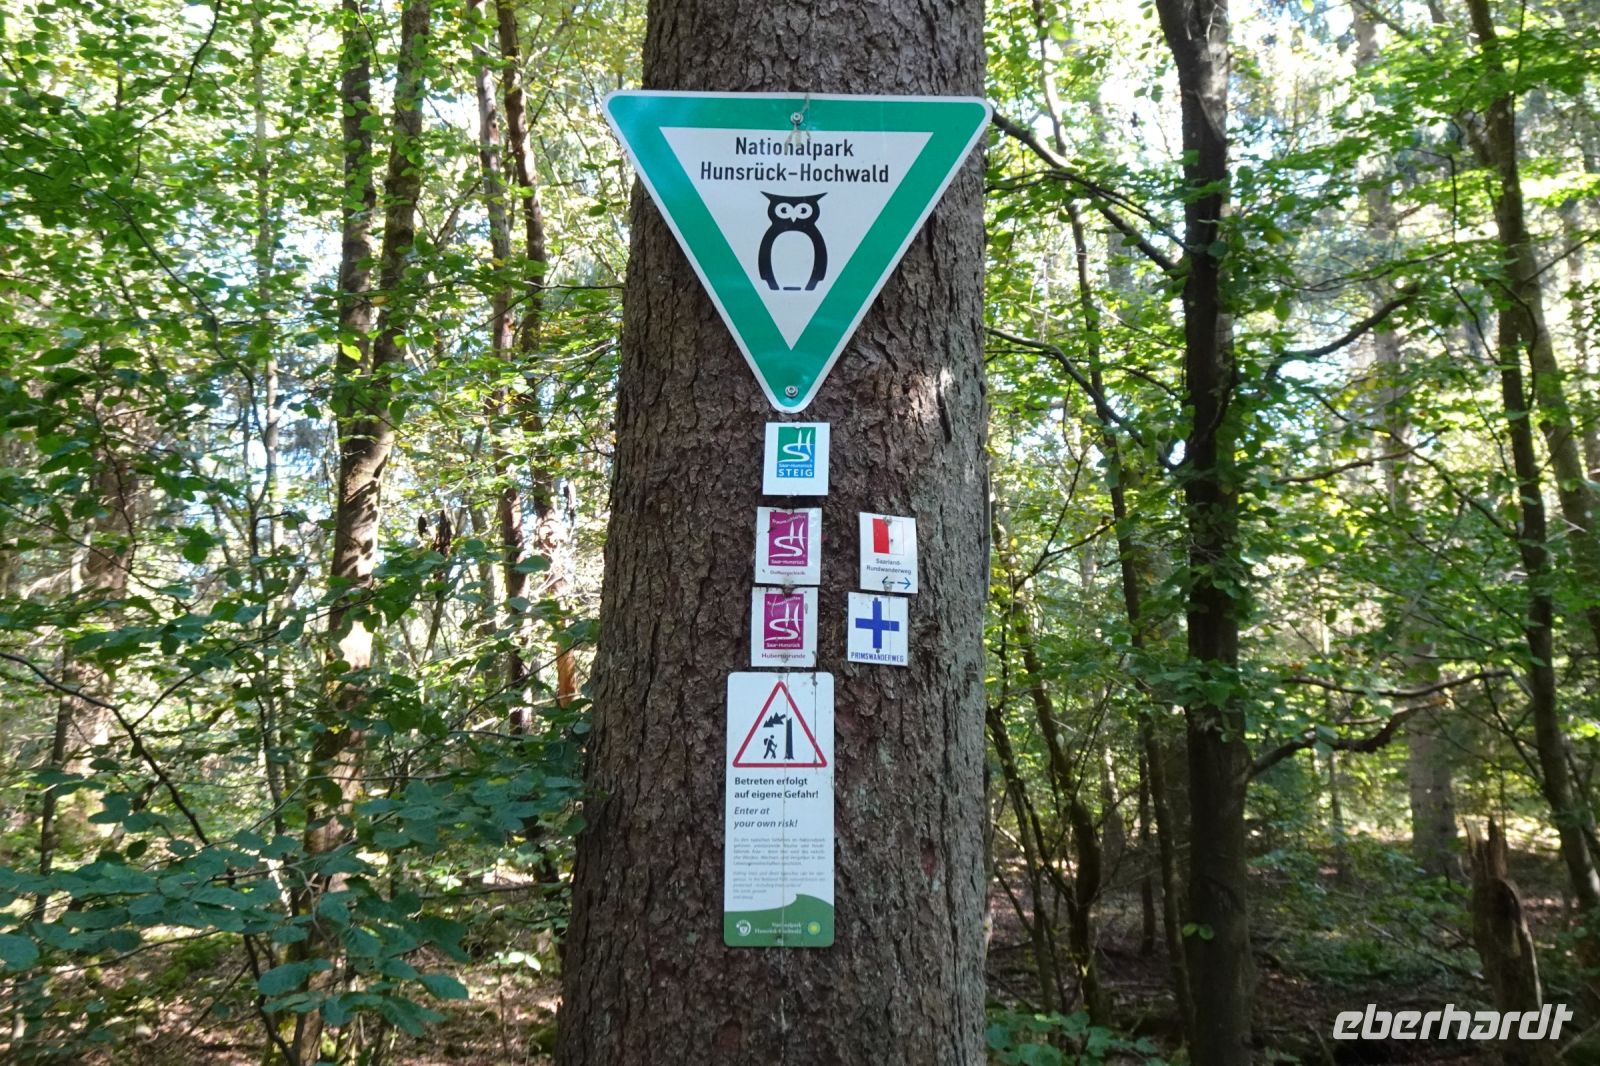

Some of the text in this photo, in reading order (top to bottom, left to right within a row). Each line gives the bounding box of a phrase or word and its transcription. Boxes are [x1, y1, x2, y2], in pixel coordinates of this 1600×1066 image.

[736, 137, 854, 160] Nationalpark
[701, 161, 889, 183] Hunsrück-Hochwald
[779, 469, 813, 477] STEIG
[734, 777, 808, 787] Betreten erfolgt
[734, 790, 819, 800] auf eigene Gefahr!
[734, 806, 770, 815] Enter at
[734, 819, 799, 830] your own risk!
